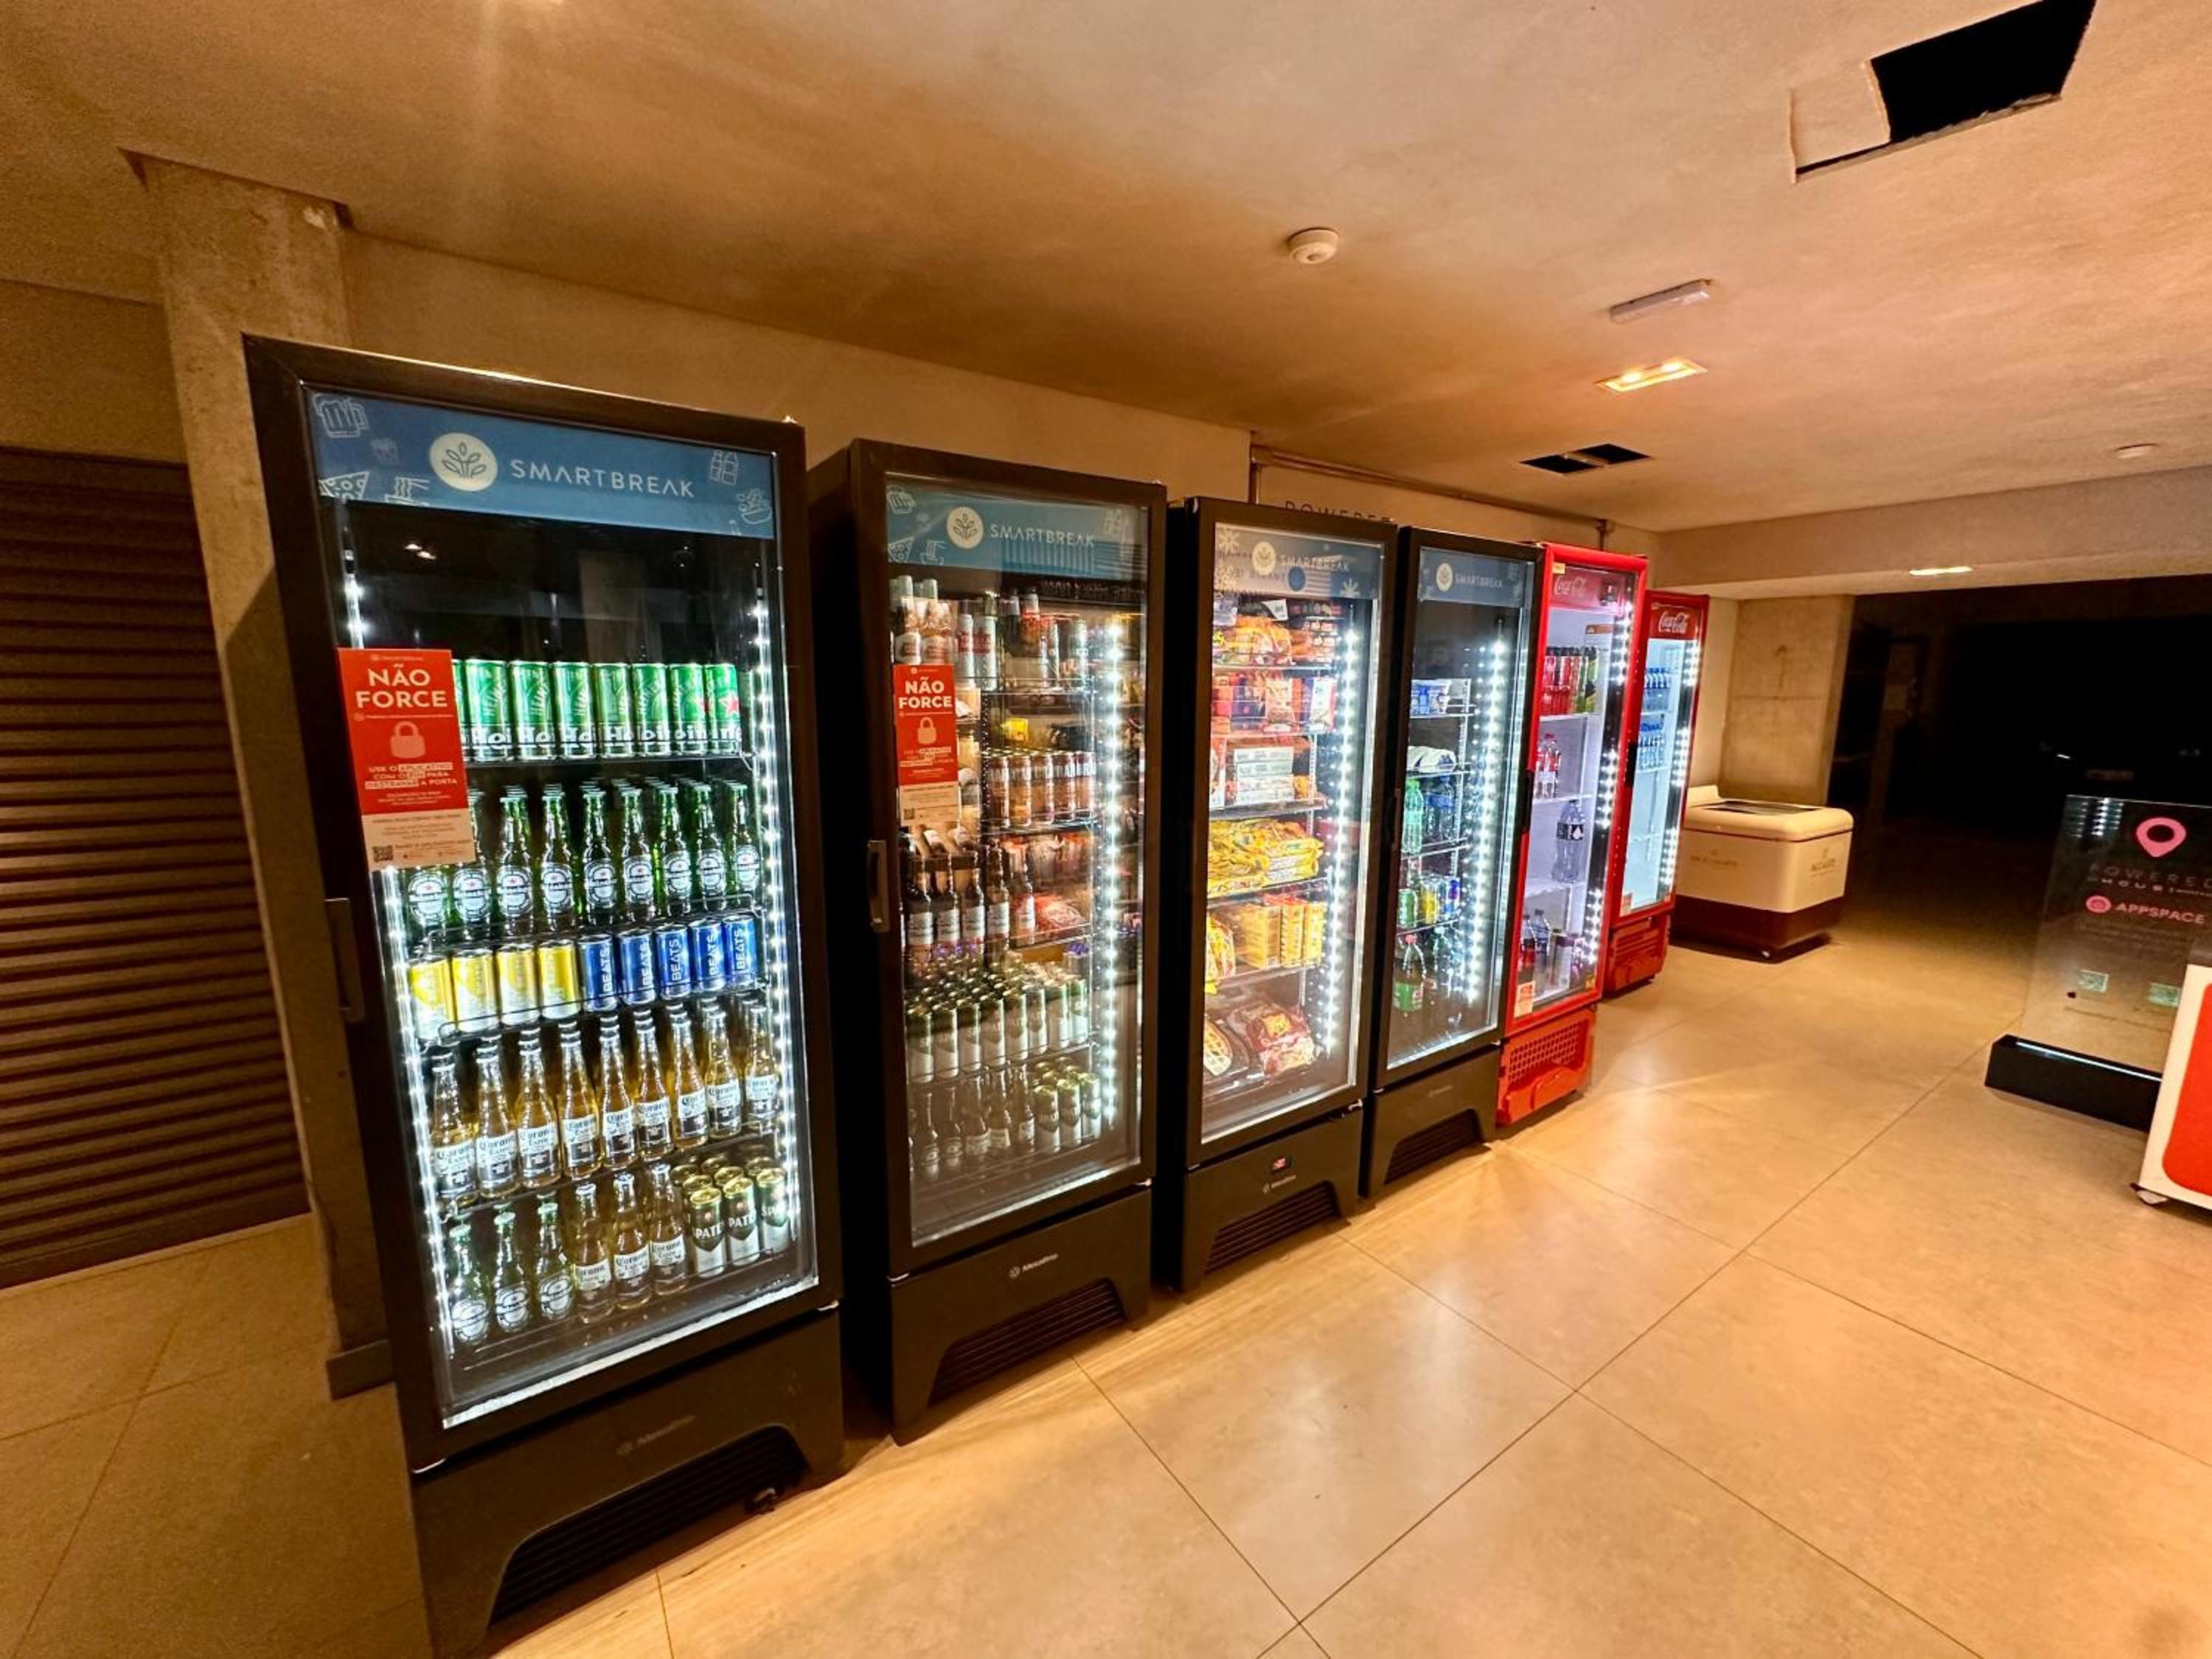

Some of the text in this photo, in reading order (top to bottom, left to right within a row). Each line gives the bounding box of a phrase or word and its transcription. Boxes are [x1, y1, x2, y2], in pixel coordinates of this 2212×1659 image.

[510, 459, 695, 498] SMARTBREAK
[990, 524, 1095, 548] SMARTBREAK
[1280, 554, 1350, 572] SMARTBREAK
[368, 663, 431, 686] NÃO
[905, 676, 945, 694] NÃO
[355, 691, 448, 709] FORCE
[898, 695, 953, 709] FORCE
[2115, 902, 2205, 925] APPSPACE
[668, 939, 682, 981] BEATS
[706, 933, 720, 976] BEATS
[734, 928, 746, 970] BEATS
[599, 947, 613, 992] BEATS
[640, 942, 653, 986] BEATS
